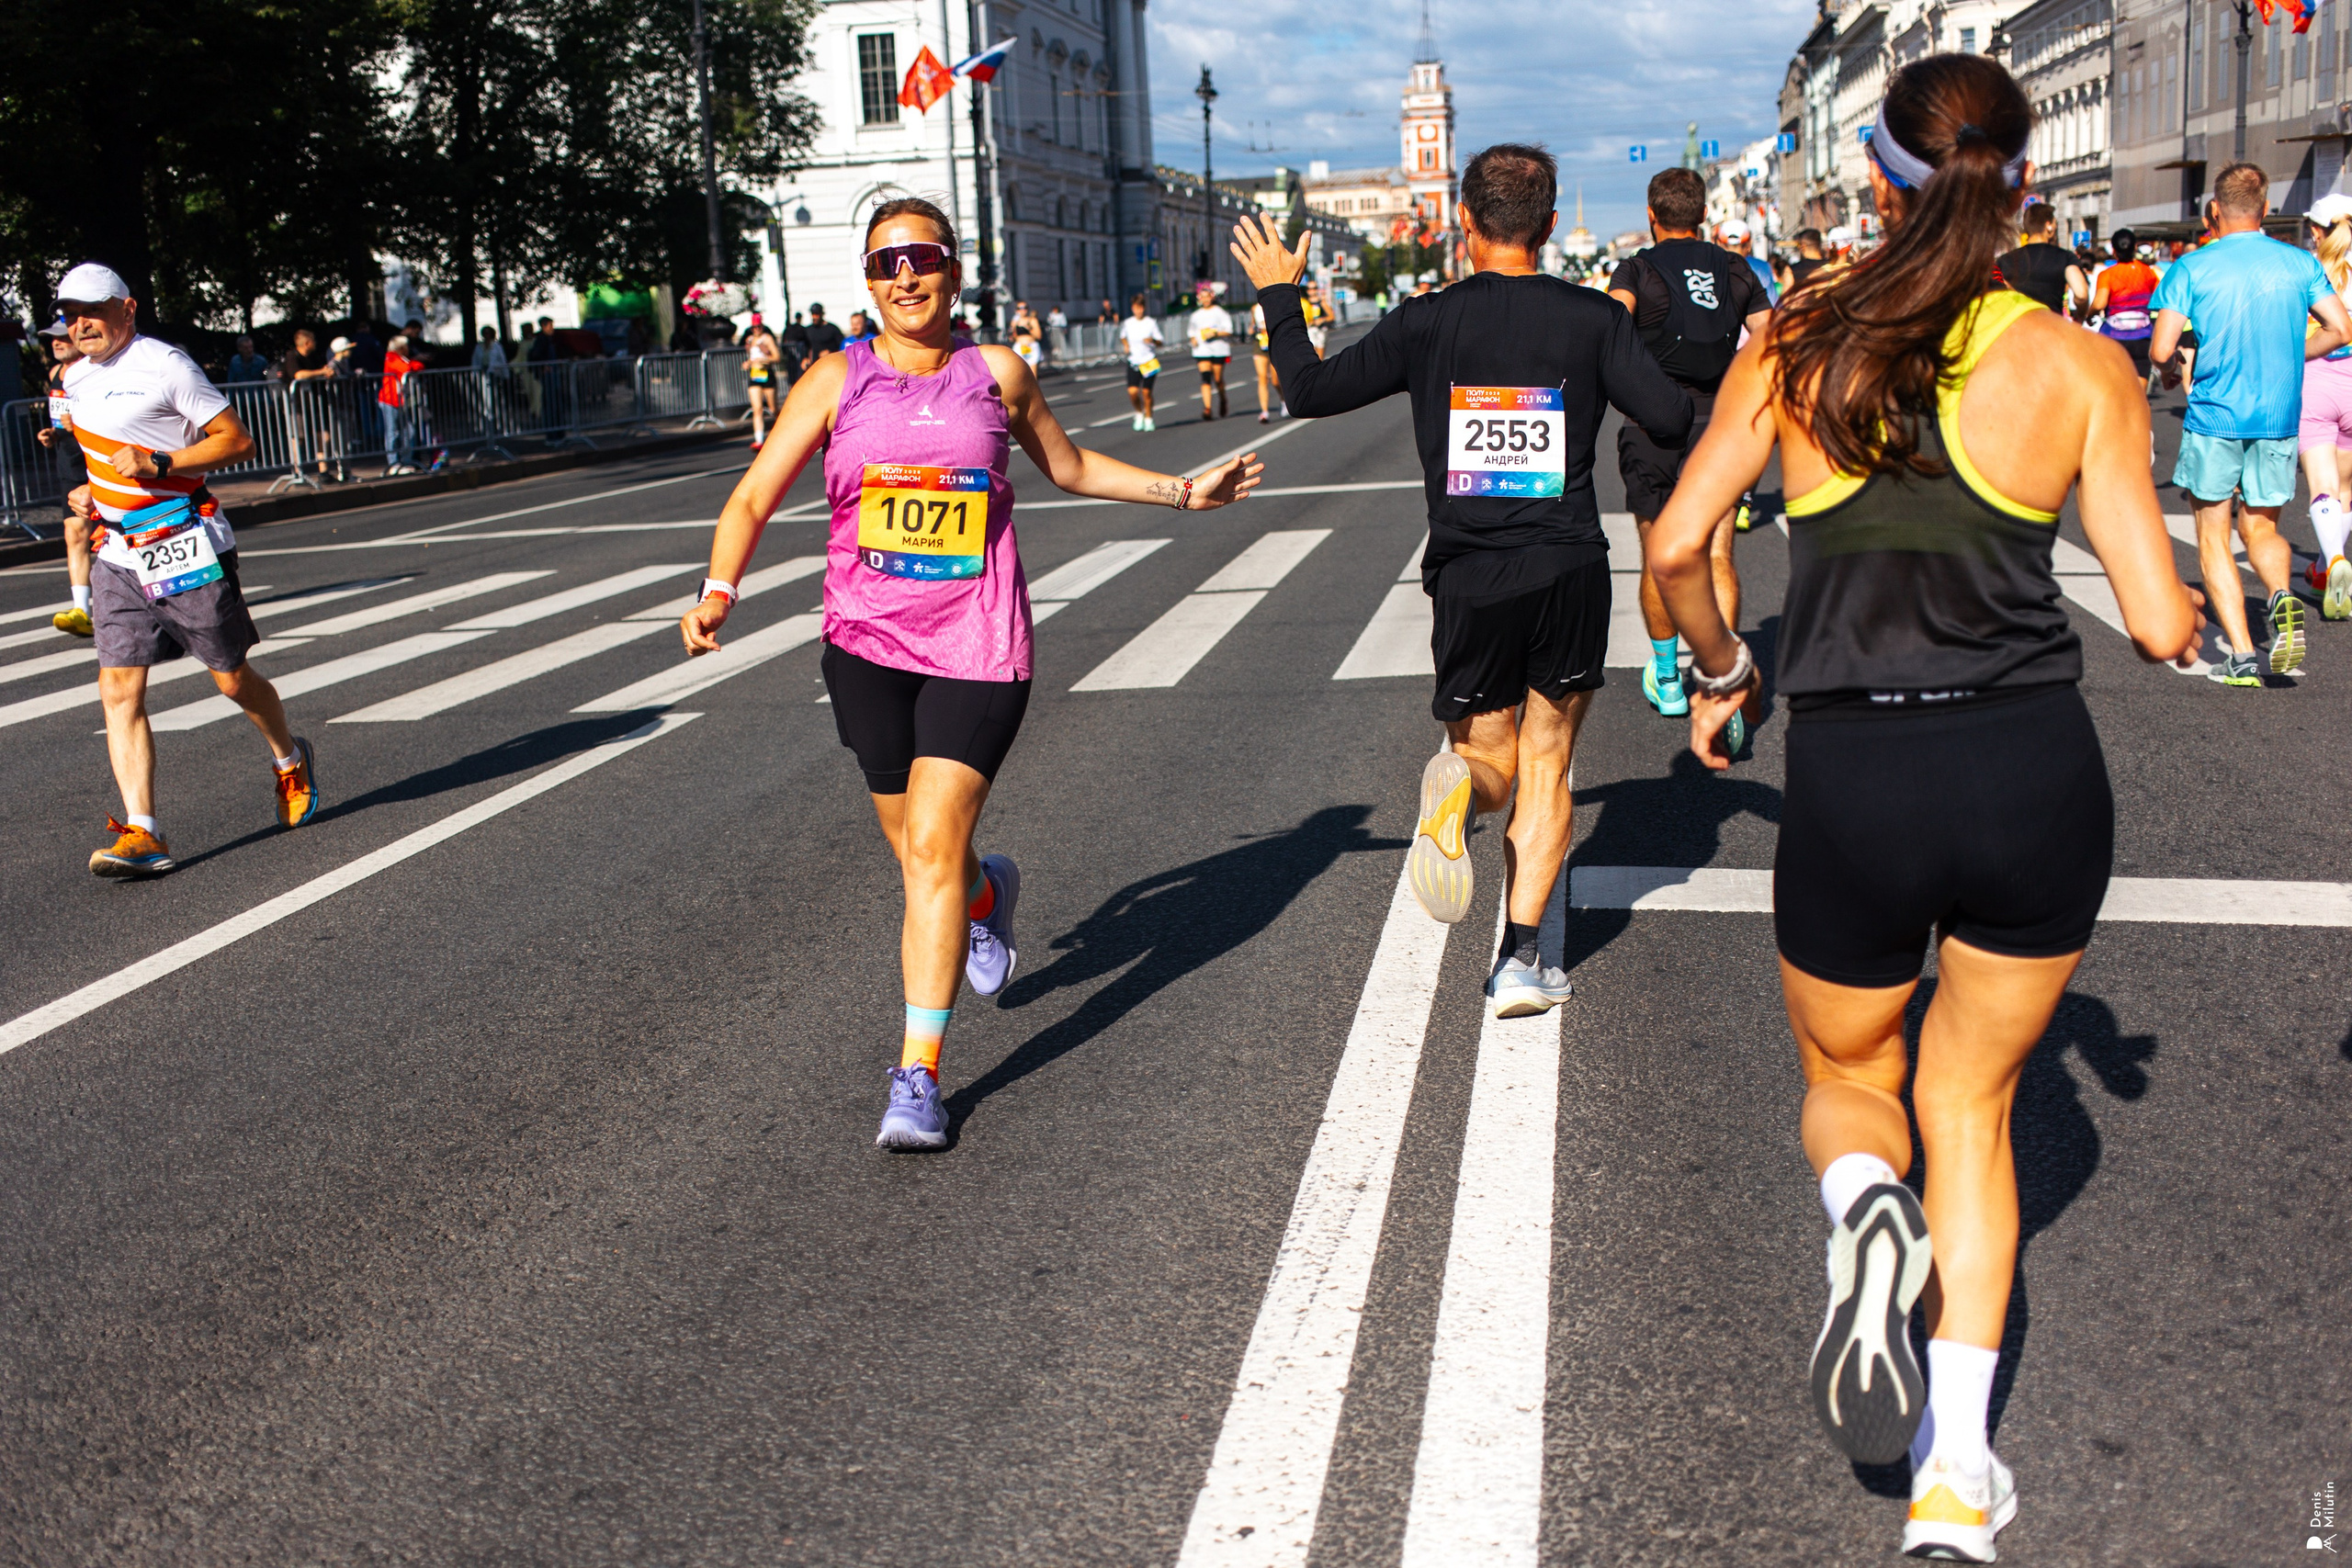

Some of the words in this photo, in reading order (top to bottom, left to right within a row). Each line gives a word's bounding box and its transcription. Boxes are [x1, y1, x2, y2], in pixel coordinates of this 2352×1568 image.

[1516, 395, 1533, 404] 21,1
[1464, 419, 1550, 452] 2553
[1484, 454, 1528, 466] АНДРЕЙ
[881, 466, 903, 475] ПОЛУ
[881, 474, 921, 482] МАРАФОН
[938, 474, 956, 485] 21,1
[1458, 474, 1472, 491] D
[881, 497, 967, 535] 1071
[902, 536, 944, 548] МАРИЯ
[141, 536, 198, 571] 2357
[869, 551, 884, 569] D
[166, 562, 190, 573] АРТЕМ
[151, 583, 164, 597] B
